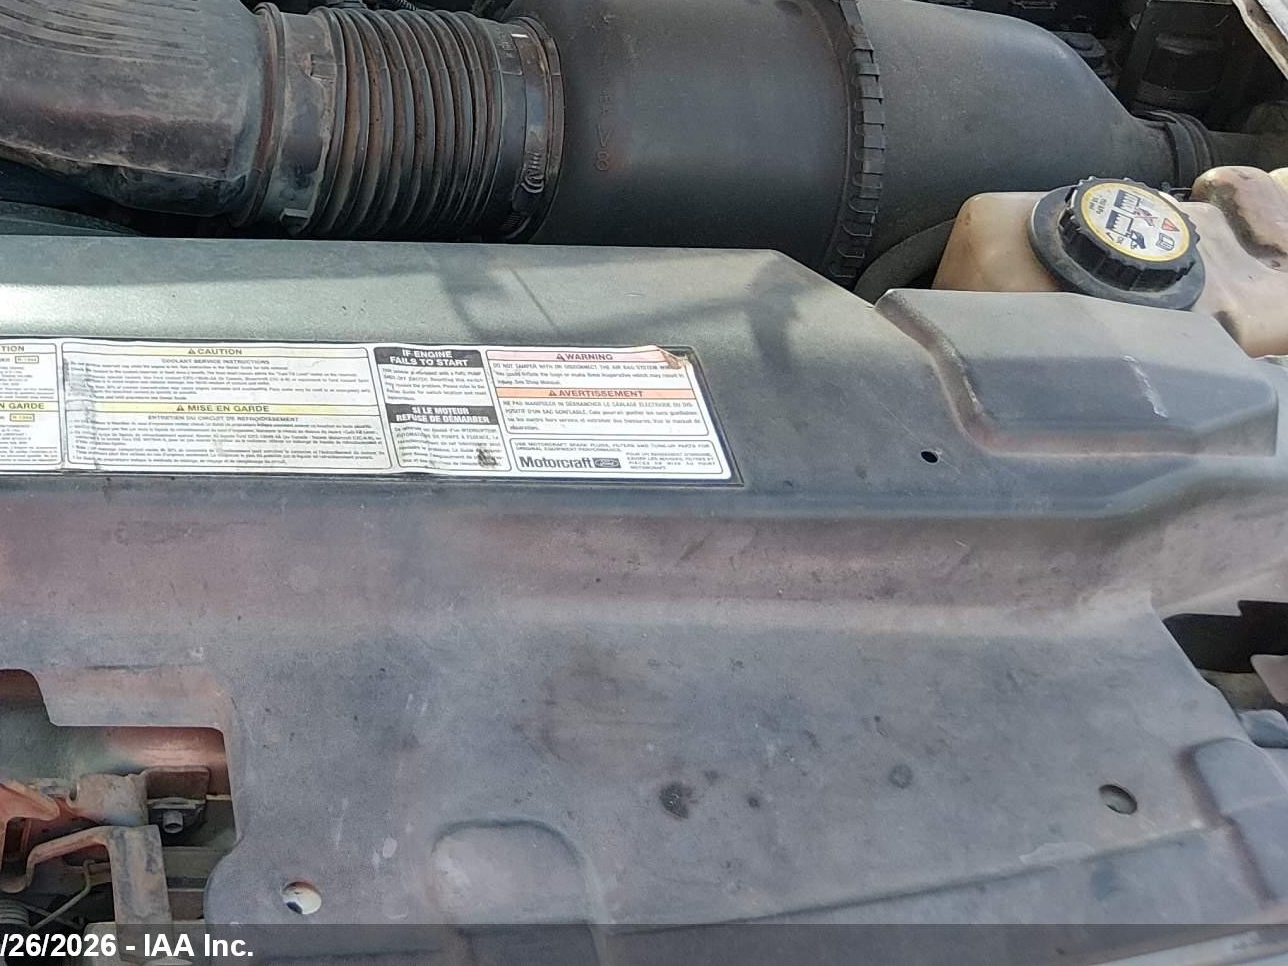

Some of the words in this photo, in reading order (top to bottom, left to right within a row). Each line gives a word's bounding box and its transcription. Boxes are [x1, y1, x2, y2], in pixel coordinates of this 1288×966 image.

[402, 349, 411, 357] IF
[412, 349, 453, 358] ENGINE
[389, 356, 418, 366] FAILS
[419, 358, 434, 366] TO
[559, 389, 643, 397] AVERTISSEMENT
[187, 404, 214, 412] MISE
[411, 406, 421, 414] SI
[422, 407, 433, 415] LE
[434, 407, 469, 415] MOTEUR
[395, 414, 428, 422] REFUSE
[428, 415, 441, 423] DE
[518, 456, 593, 468] Motorcraft
